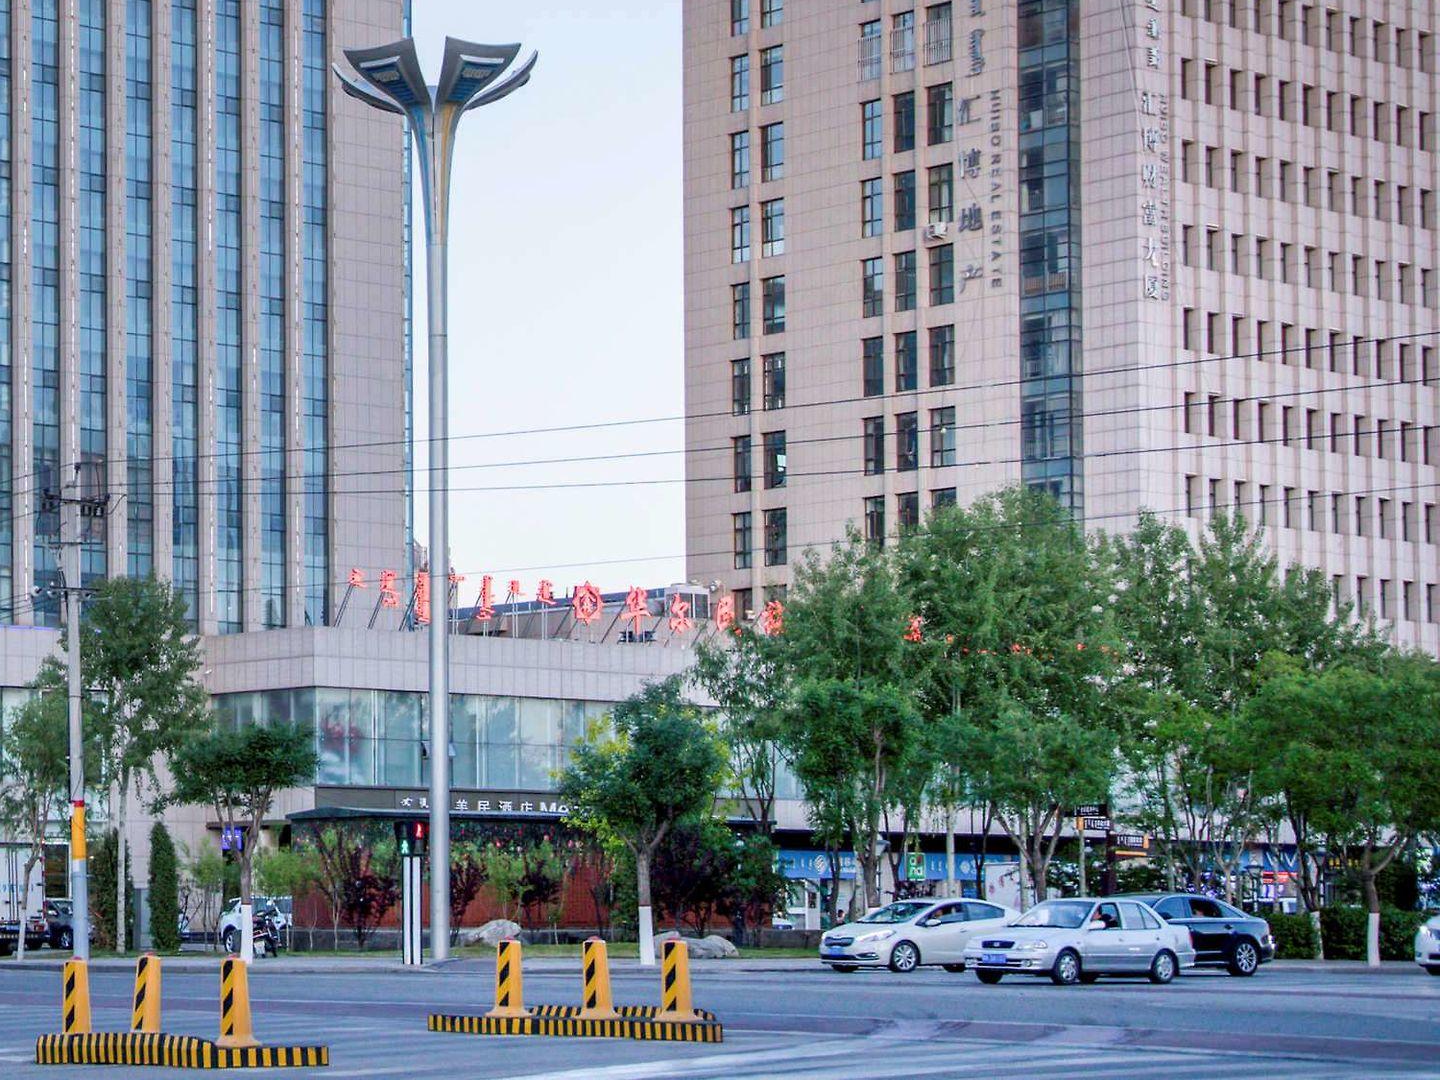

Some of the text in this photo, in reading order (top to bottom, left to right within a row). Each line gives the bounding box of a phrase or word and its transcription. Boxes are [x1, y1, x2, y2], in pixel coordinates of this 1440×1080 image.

[959, 95, 984, 295] 汇博地产
[990, 89, 1002, 289] HUIBO REAL ESTATE
